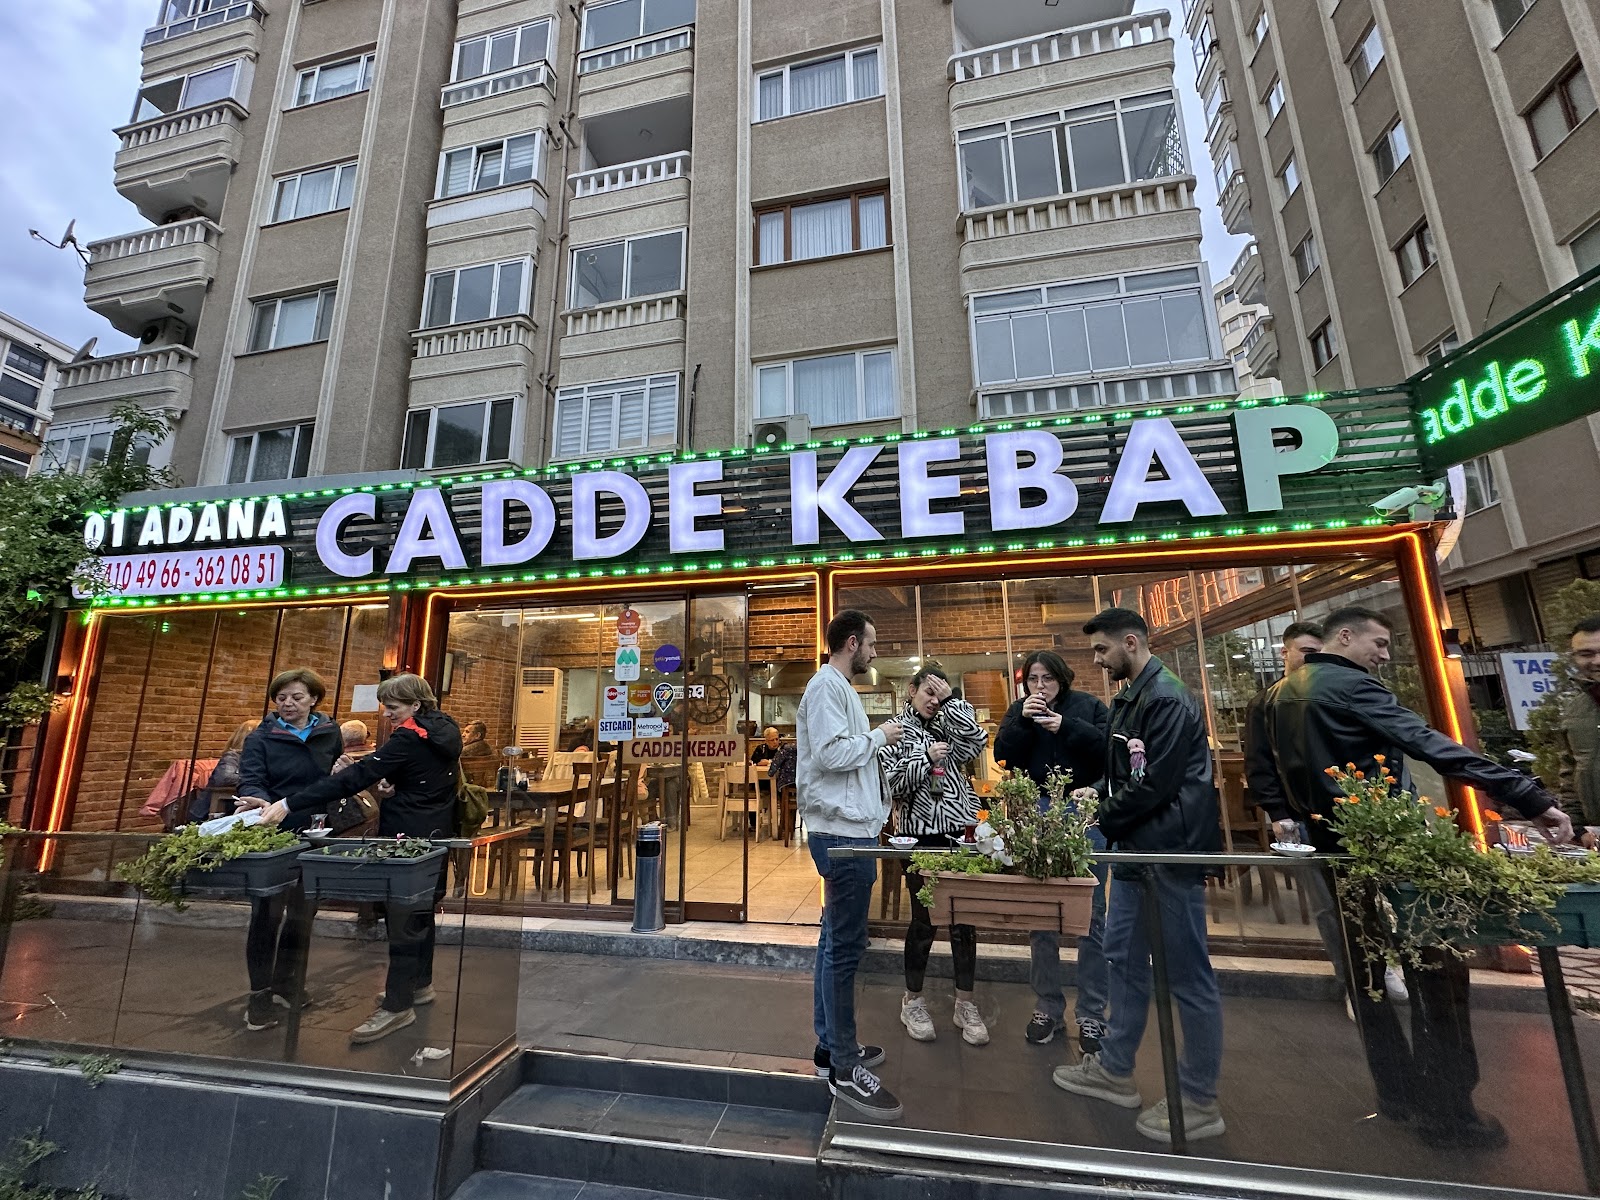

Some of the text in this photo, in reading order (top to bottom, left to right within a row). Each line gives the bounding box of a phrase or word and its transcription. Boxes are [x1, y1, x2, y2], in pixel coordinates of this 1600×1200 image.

[316, 405, 1339, 577] CADDE KEBAP
[84, 499, 286, 550] 01 ADANA
[136, 559, 157, 589] 49
[161, 558, 180, 588] 66
[194, 555, 225, 587] 362
[230, 553, 250, 585] 08
[256, 552, 275, 584] 51
[600, 720, 632, 732] SETCARD
[637, 723, 663, 733] Metropol
[631, 740, 737, 758] CADDE KEBAP
